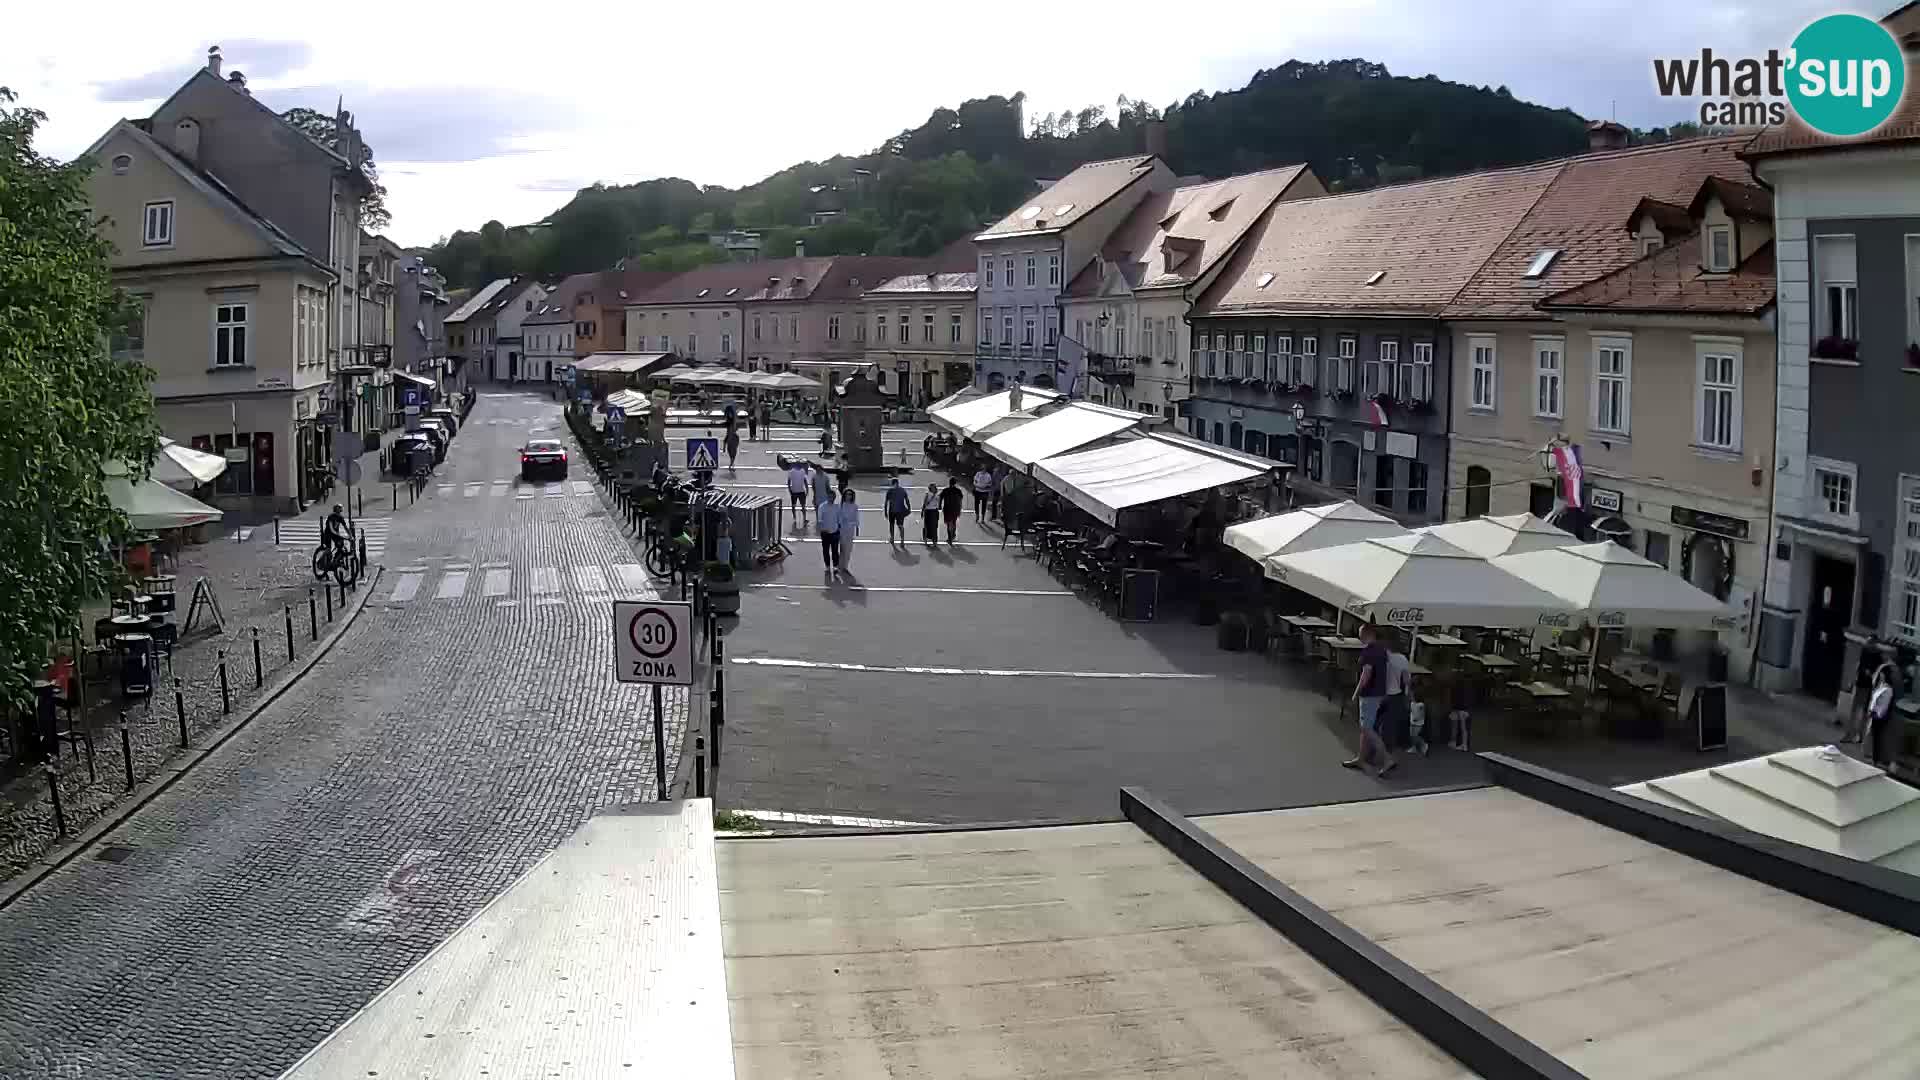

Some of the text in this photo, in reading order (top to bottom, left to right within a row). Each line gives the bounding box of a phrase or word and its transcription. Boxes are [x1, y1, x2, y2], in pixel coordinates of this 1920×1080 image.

[408, 392, 416, 404] P
[642, 623, 666, 645] 30
[632, 662, 676, 678] ZONA
